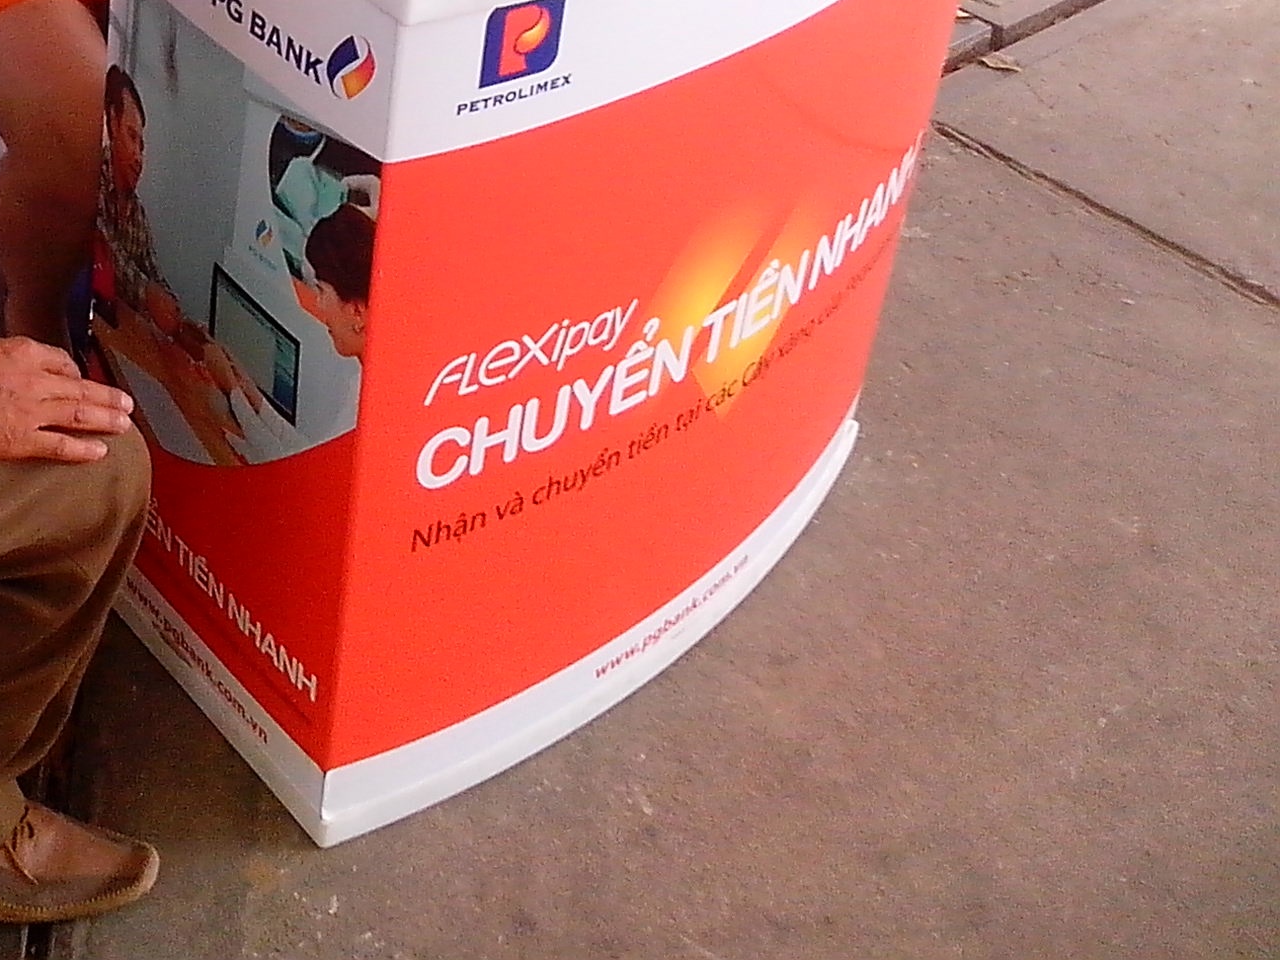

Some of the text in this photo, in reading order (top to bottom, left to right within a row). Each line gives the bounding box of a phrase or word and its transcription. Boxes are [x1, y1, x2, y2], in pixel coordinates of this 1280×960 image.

[248, 8, 324, 85] BANK
[457, 73, 572, 116] PETROLIMEX
[416, 317, 694, 489] CHUYỂN
[410, 511, 487, 553] Nhận
[496, 491, 524, 520] và
[531, 446, 622, 506] chuyển
[706, 378, 739, 412] các
[228, 593, 317, 703] NHANH
[595, 554, 749, 679] www.pgbank.com.vn
